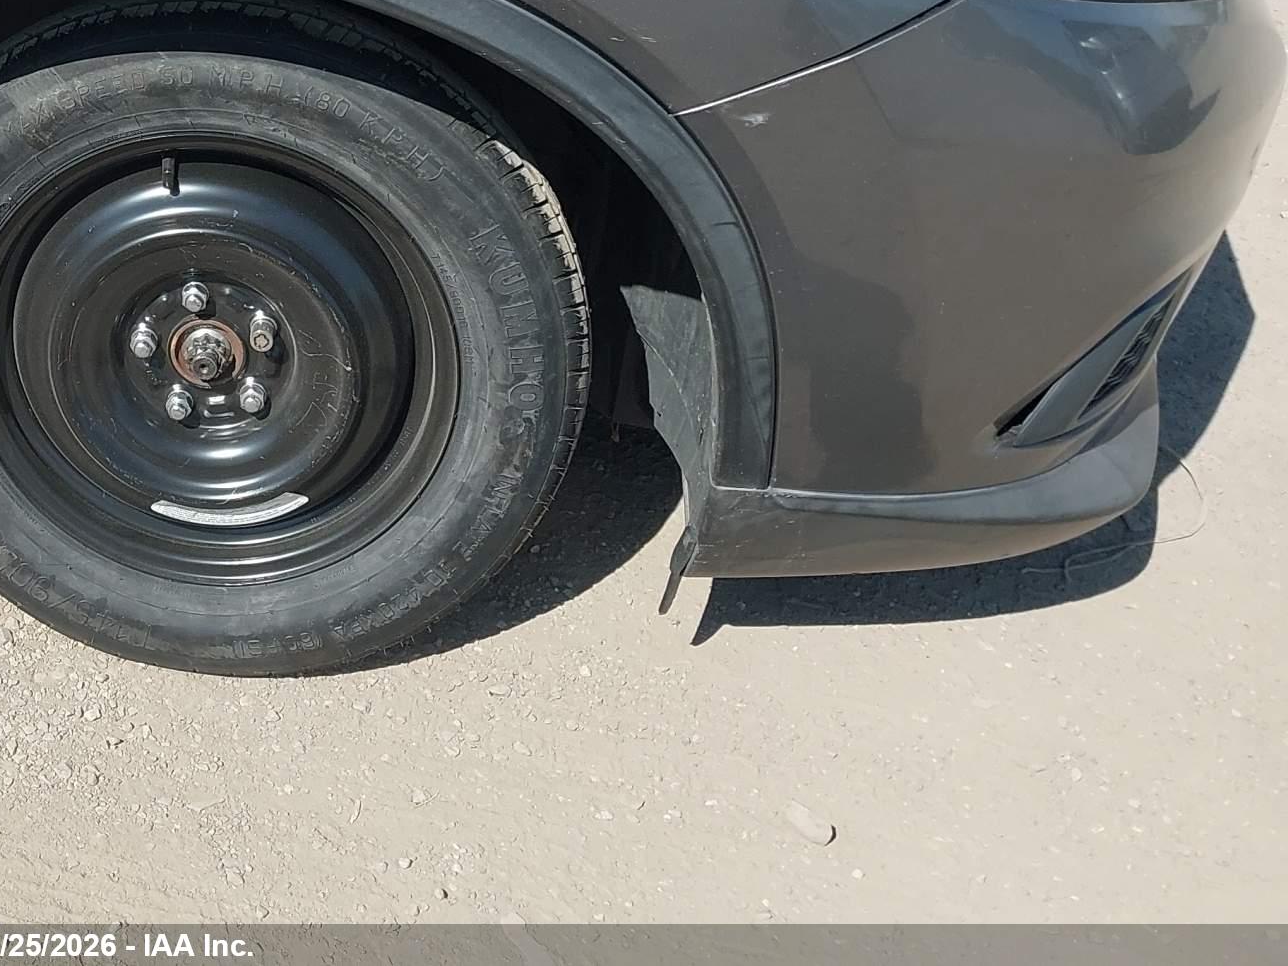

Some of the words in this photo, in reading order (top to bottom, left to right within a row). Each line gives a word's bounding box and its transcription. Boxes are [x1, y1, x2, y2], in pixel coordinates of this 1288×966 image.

[159, 65, 195, 85] 50
[303, 85, 353, 119] (80
[468, 223, 545, 412] KUMHO
